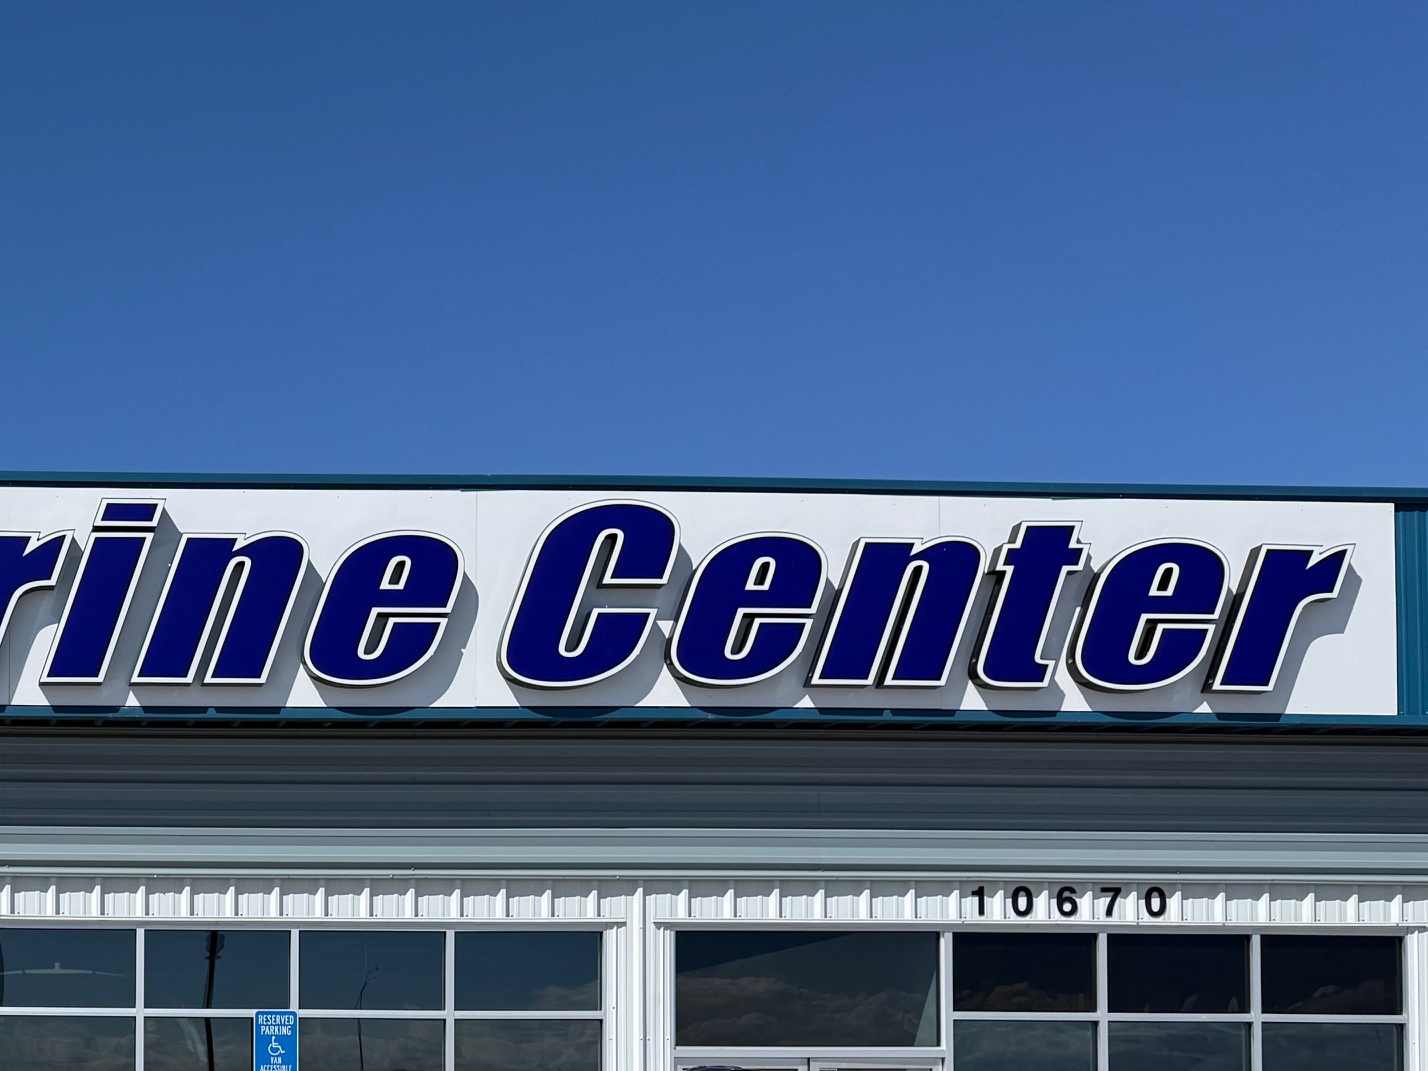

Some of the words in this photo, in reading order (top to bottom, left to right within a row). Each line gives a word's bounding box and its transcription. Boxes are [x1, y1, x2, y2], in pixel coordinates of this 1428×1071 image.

[498, 498, 1357, 693] Center
[970, 886, 1168, 918] 10670
[258, 1015, 294, 1025] RESERVED
[260, 1026, 291, 1035] PARKING
